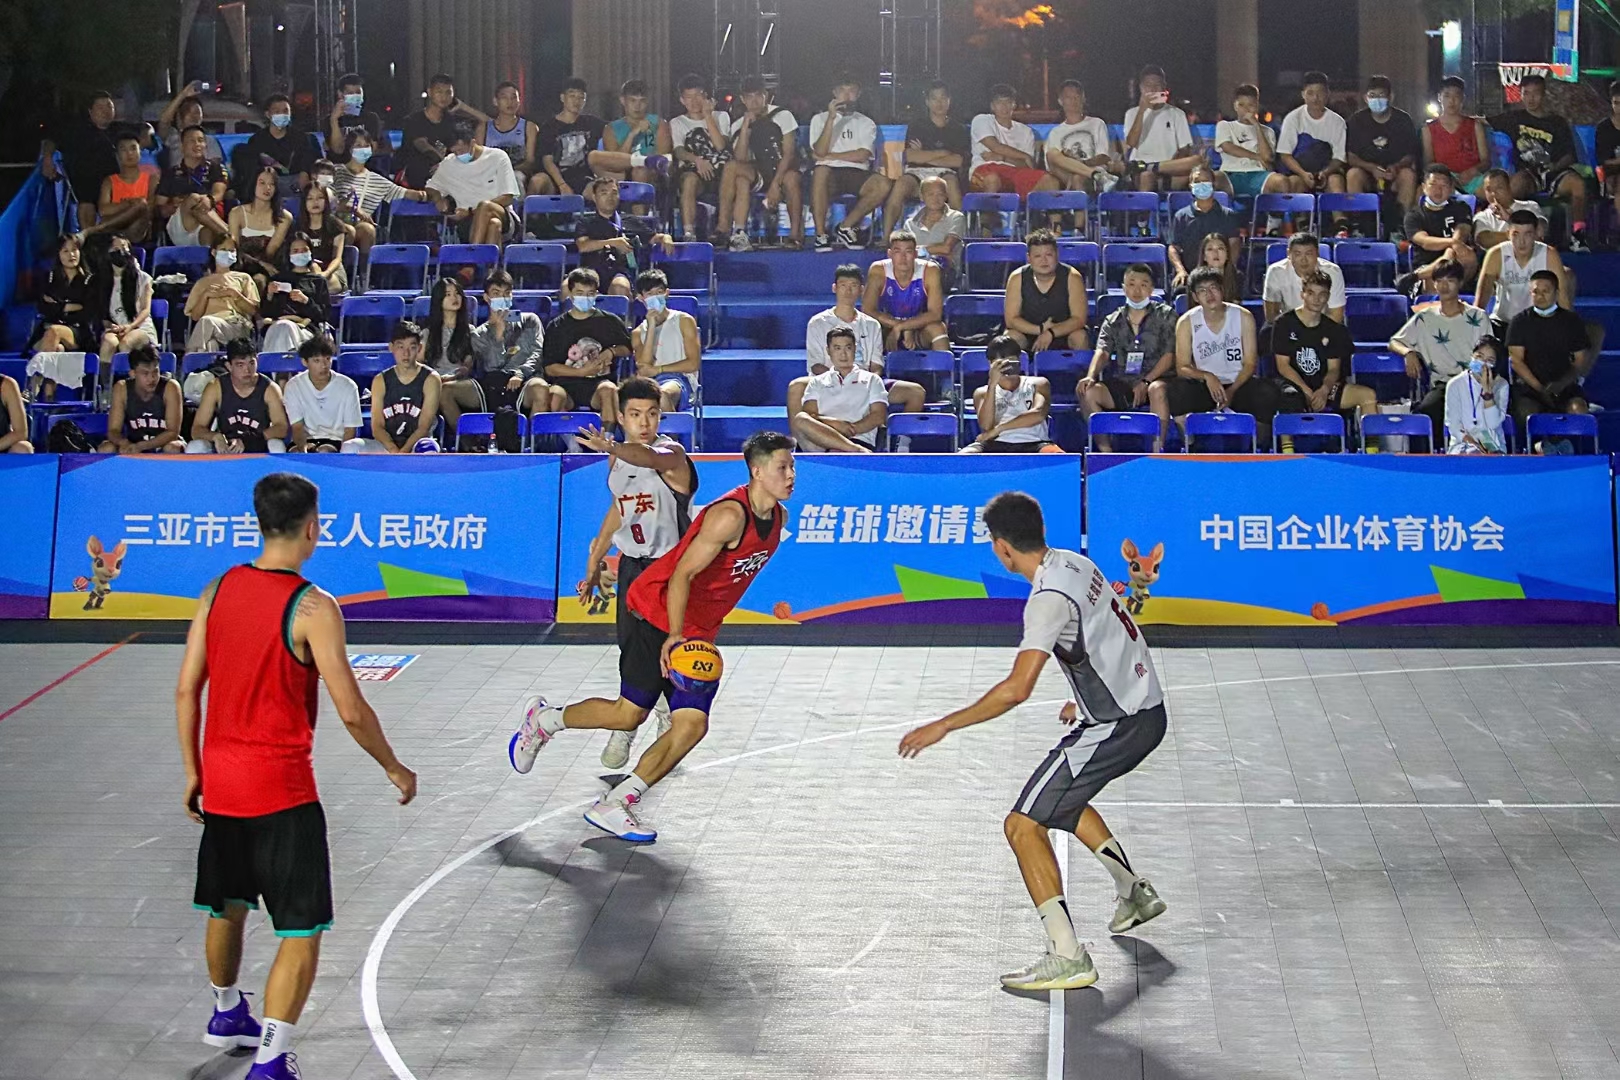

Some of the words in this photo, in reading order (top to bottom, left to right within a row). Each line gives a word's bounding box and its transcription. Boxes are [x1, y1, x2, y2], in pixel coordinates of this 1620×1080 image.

[1226, 348, 1242, 362] 52
[617, 491, 656, 518] 广东
[120, 511, 488, 550] 三亚市吉区人民政府
[630, 523, 646, 545] 8
[780, 504, 993, 545] 篮球邀请
[1200, 513, 1506, 552] 中国企业体育协会
